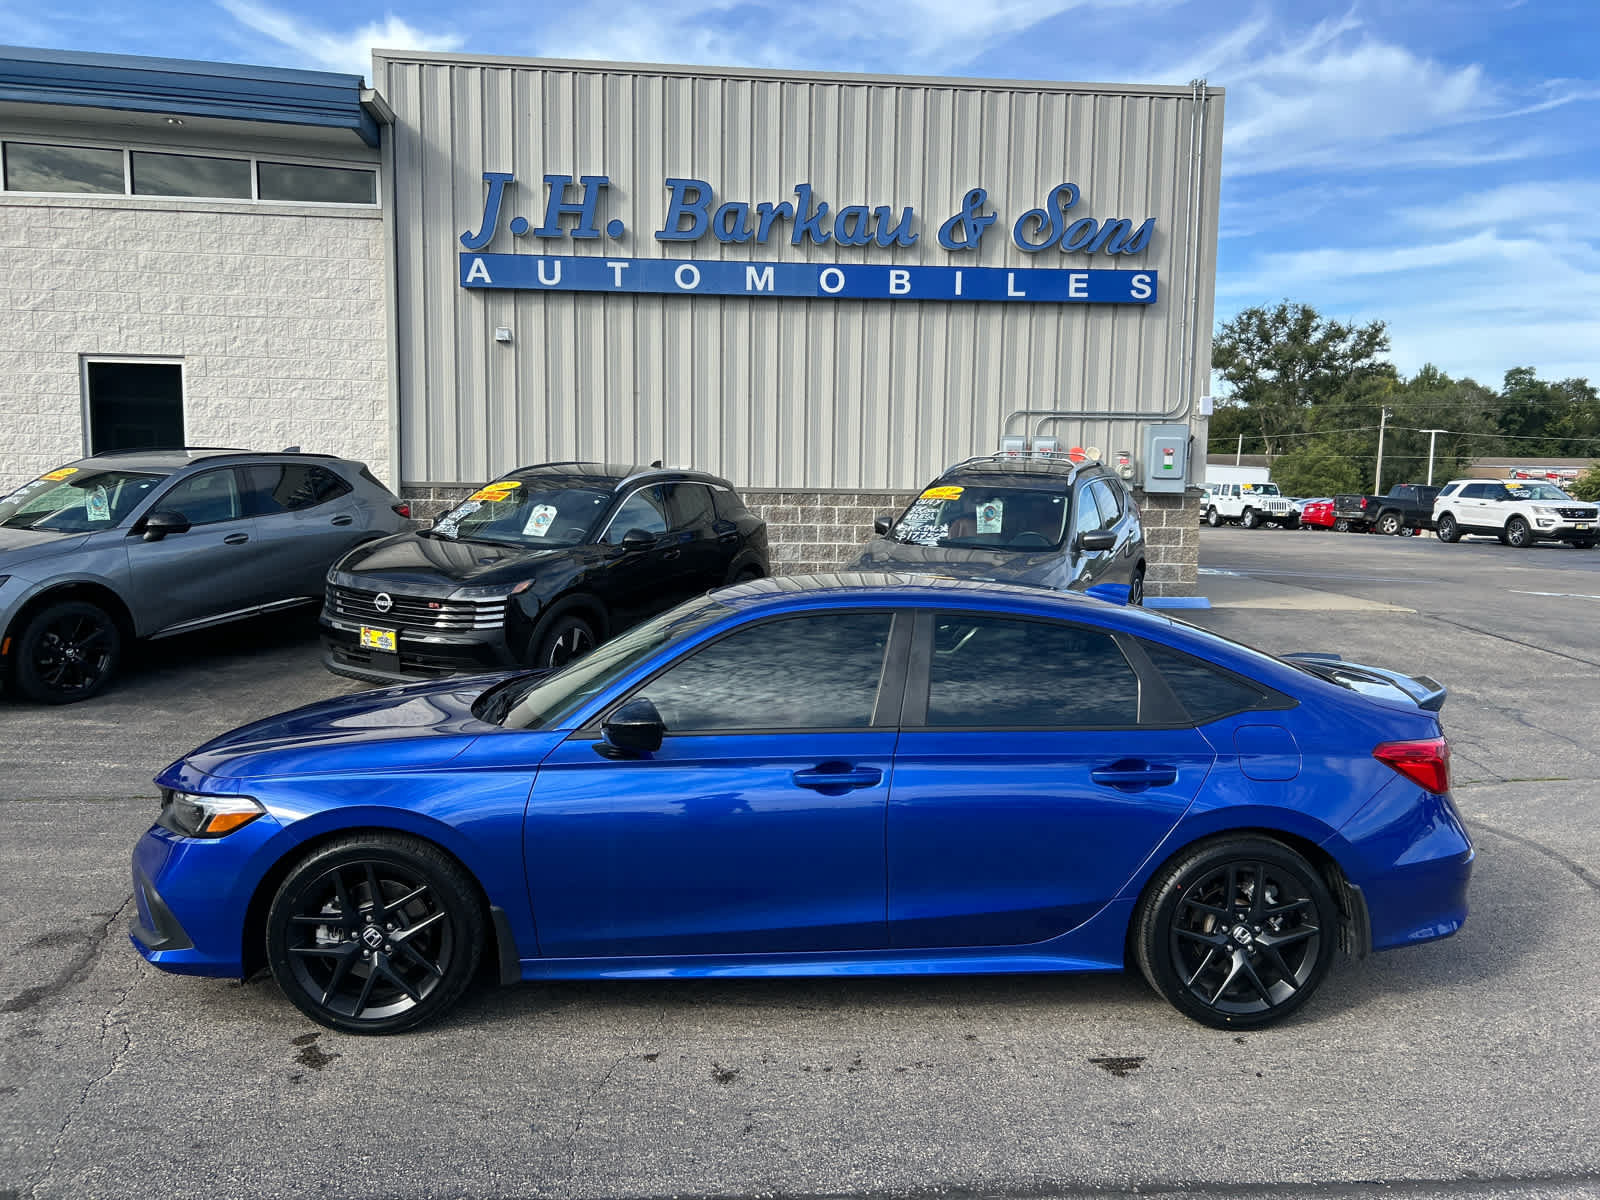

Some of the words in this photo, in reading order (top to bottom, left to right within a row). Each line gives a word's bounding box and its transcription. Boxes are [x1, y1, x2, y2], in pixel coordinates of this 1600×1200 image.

[460, 172, 625, 250] J.H.
[655, 178, 919, 247] Barkau
[937, 187, 998, 252] &
[1012, 183, 1156, 255] Sons
[465, 257, 1152, 299] AUTOMOBILES
